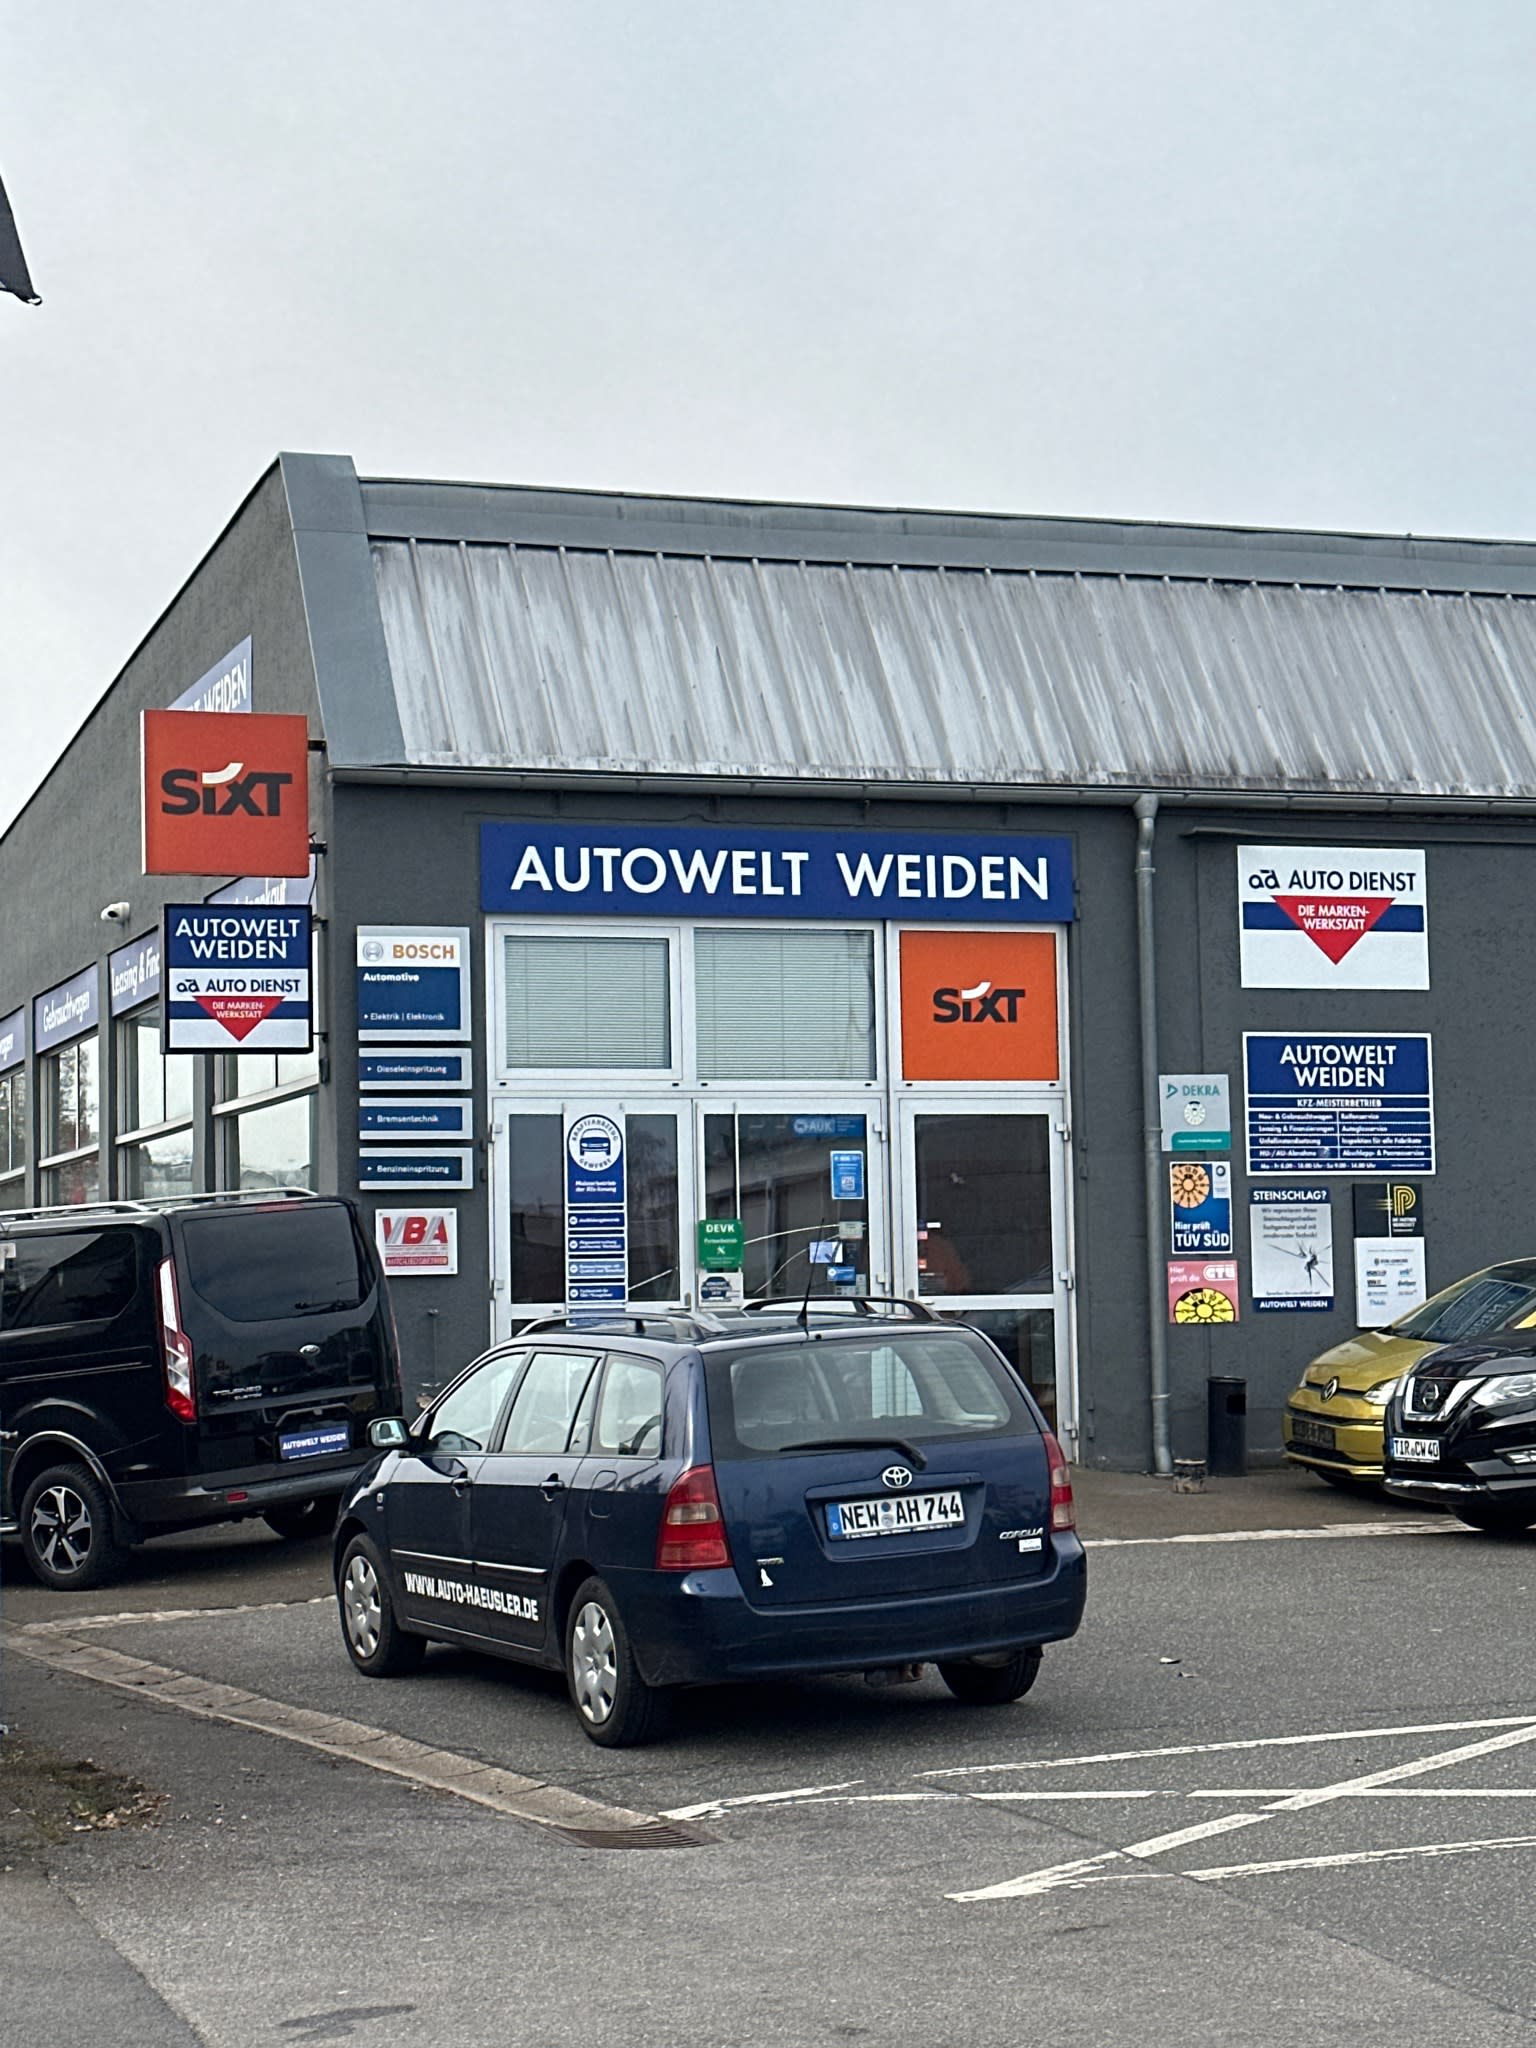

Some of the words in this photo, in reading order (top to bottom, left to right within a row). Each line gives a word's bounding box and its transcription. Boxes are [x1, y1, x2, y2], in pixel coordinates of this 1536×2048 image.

[161, 762, 292, 817] SIXT
[510, 846, 808, 896] AUTOWELT
[836, 853, 1049, 901] WEIDEN
[1288, 870, 1343, 890] AUTO
[1349, 871, 1416, 892] DIENST
[1298, 905, 1315, 917] DIE
[1318, 905, 1370, 917] MARKEN-
[175, 918, 300, 938] AUTOWELT
[1303, 918, 1365, 930] WERKSTATT
[190, 939, 287, 959] WEIDEN
[392, 944, 455, 959] BOSCH
[112, 960, 138, 997] Leasing
[138, 951, 145, 984] &
[363, 972, 420, 982] Automotive
[205, 979, 247, 993] AUTO
[250, 979, 300, 993] DIENST
[212, 1001, 225, 1010] DIE
[227, 1001, 265, 1010] MARKEN-
[933, 981, 1026, 1023] SIXT
[43, 991, 90, 1033] Gebrauchtwagen
[216, 1010, 263, 1019] WERKSTATT
[370, 1013, 400, 1021] Elektrik
[406, 1013, 445, 1021] Elektronik
[1280, 1045, 1397, 1065] AUTOWELT
[376, 1065, 447, 1074] Dieseleinspritzung
[1293, 1067, 1385, 1087] WEIDEN
[1182, 1084, 1220, 1096] DEKRA
[1297, 1098, 1382, 1108] KFZ-MEISTERBETRIEB
[377, 1115, 439, 1123] Bremsentechnik
[377, 1165, 449, 1174] Benzineinspritzung
[1253, 1190, 1327, 1201] STEINSCHLAG?
[382, 1216, 448, 1245] VBA
[706, 1223, 735, 1233] DEVK
[1174, 1221, 1191, 1230] Hier
[1192, 1221, 1211, 1232] prüft
[1175, 1231, 1200, 1247] TÜV
[1203, 1230, 1230, 1247] SÜD
[1189, 1274, 1200, 1282] die
[1260, 1300, 1297, 1309] AUTOWELT
[1299, 1300, 1328, 1308] WEIDEN
[282, 1437, 319, 1450] AUTOWELT
[320, 1432, 347, 1443] WEIDEN
[1394, 1440, 1410, 1456] TIR
[1428, 1442, 1439, 1457] 40
[840, 1503, 879, 1531] NEW
[896, 1499, 921, 1524] AH
[924, 1495, 961, 1521] 744
[404, 1572, 539, 1621] WWW.AUTO-HAEUSLER.DE
